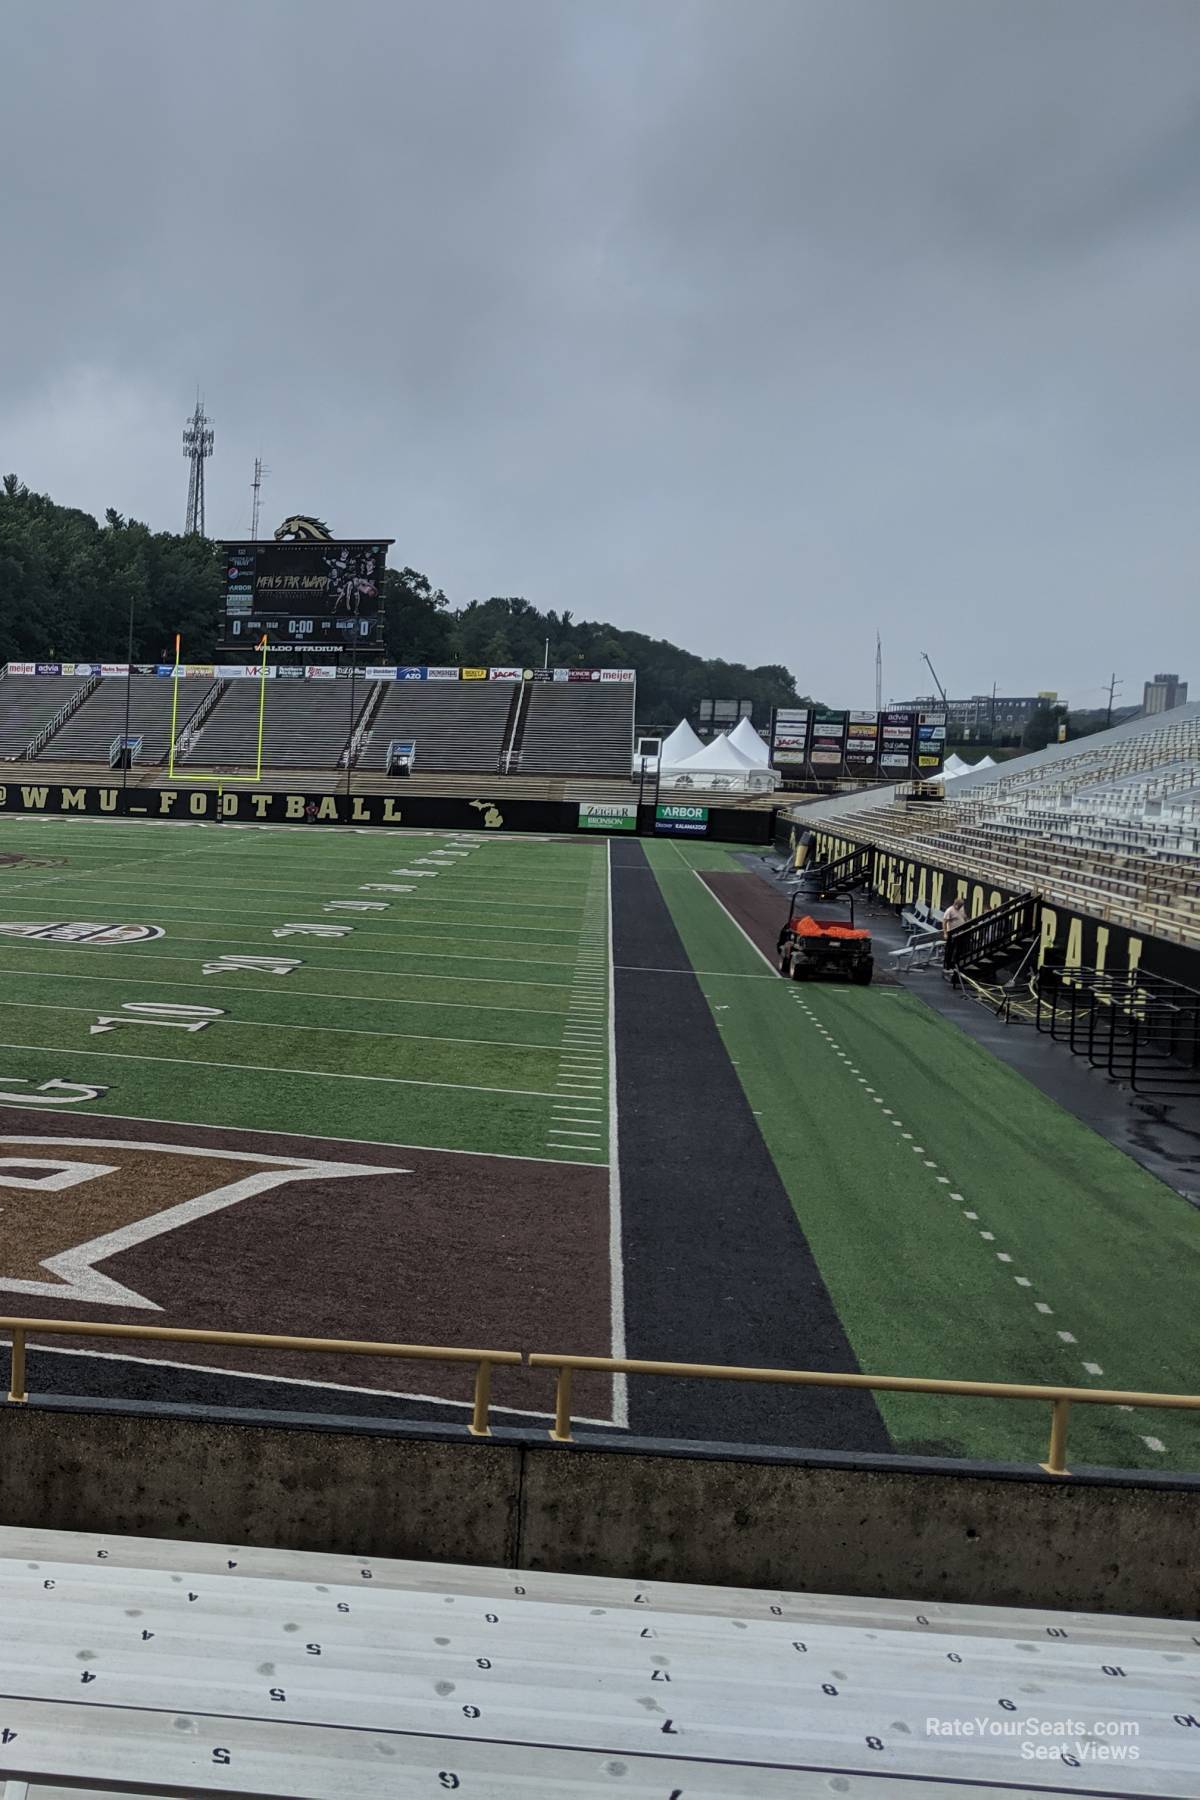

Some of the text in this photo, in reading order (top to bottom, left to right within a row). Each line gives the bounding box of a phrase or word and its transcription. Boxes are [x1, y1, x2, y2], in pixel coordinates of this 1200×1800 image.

[9, 664, 33, 674] meijer
[602, 671, 633, 681] meijer
[662, 806, 703, 818] ARBOR
[587, 817, 623, 825] BRONSON
[96, 1549, 109, 1559] 3
[227, 1560, 238, 1569] 4
[360, 1569, 373, 1579] 5
[43, 1579, 56, 1590] 3
[188, 1592, 199, 1602] 4
[336, 1602, 350, 1613] 5
[769, 1605, 783, 1616] 8
[141, 1629, 155, 1641] 4
[1046, 1627, 1069, 1639] 10
[306, 1643, 322, 1656] 5
[791, 1641, 808, 1653] 8
[80, 1670, 97, 1684] 4
[650, 1669, 672, 1682] 7
[1101, 1665, 1127, 1678] 10
[269, 1688, 286, 1702] 5
[821, 1683, 839, 1697] 8
[660, 1719, 678, 1735] 7
[1, 1727, 18, 1745] 4
[865, 1736, 885, 1751] 8
[211, 1747, 231, 1765] 5
